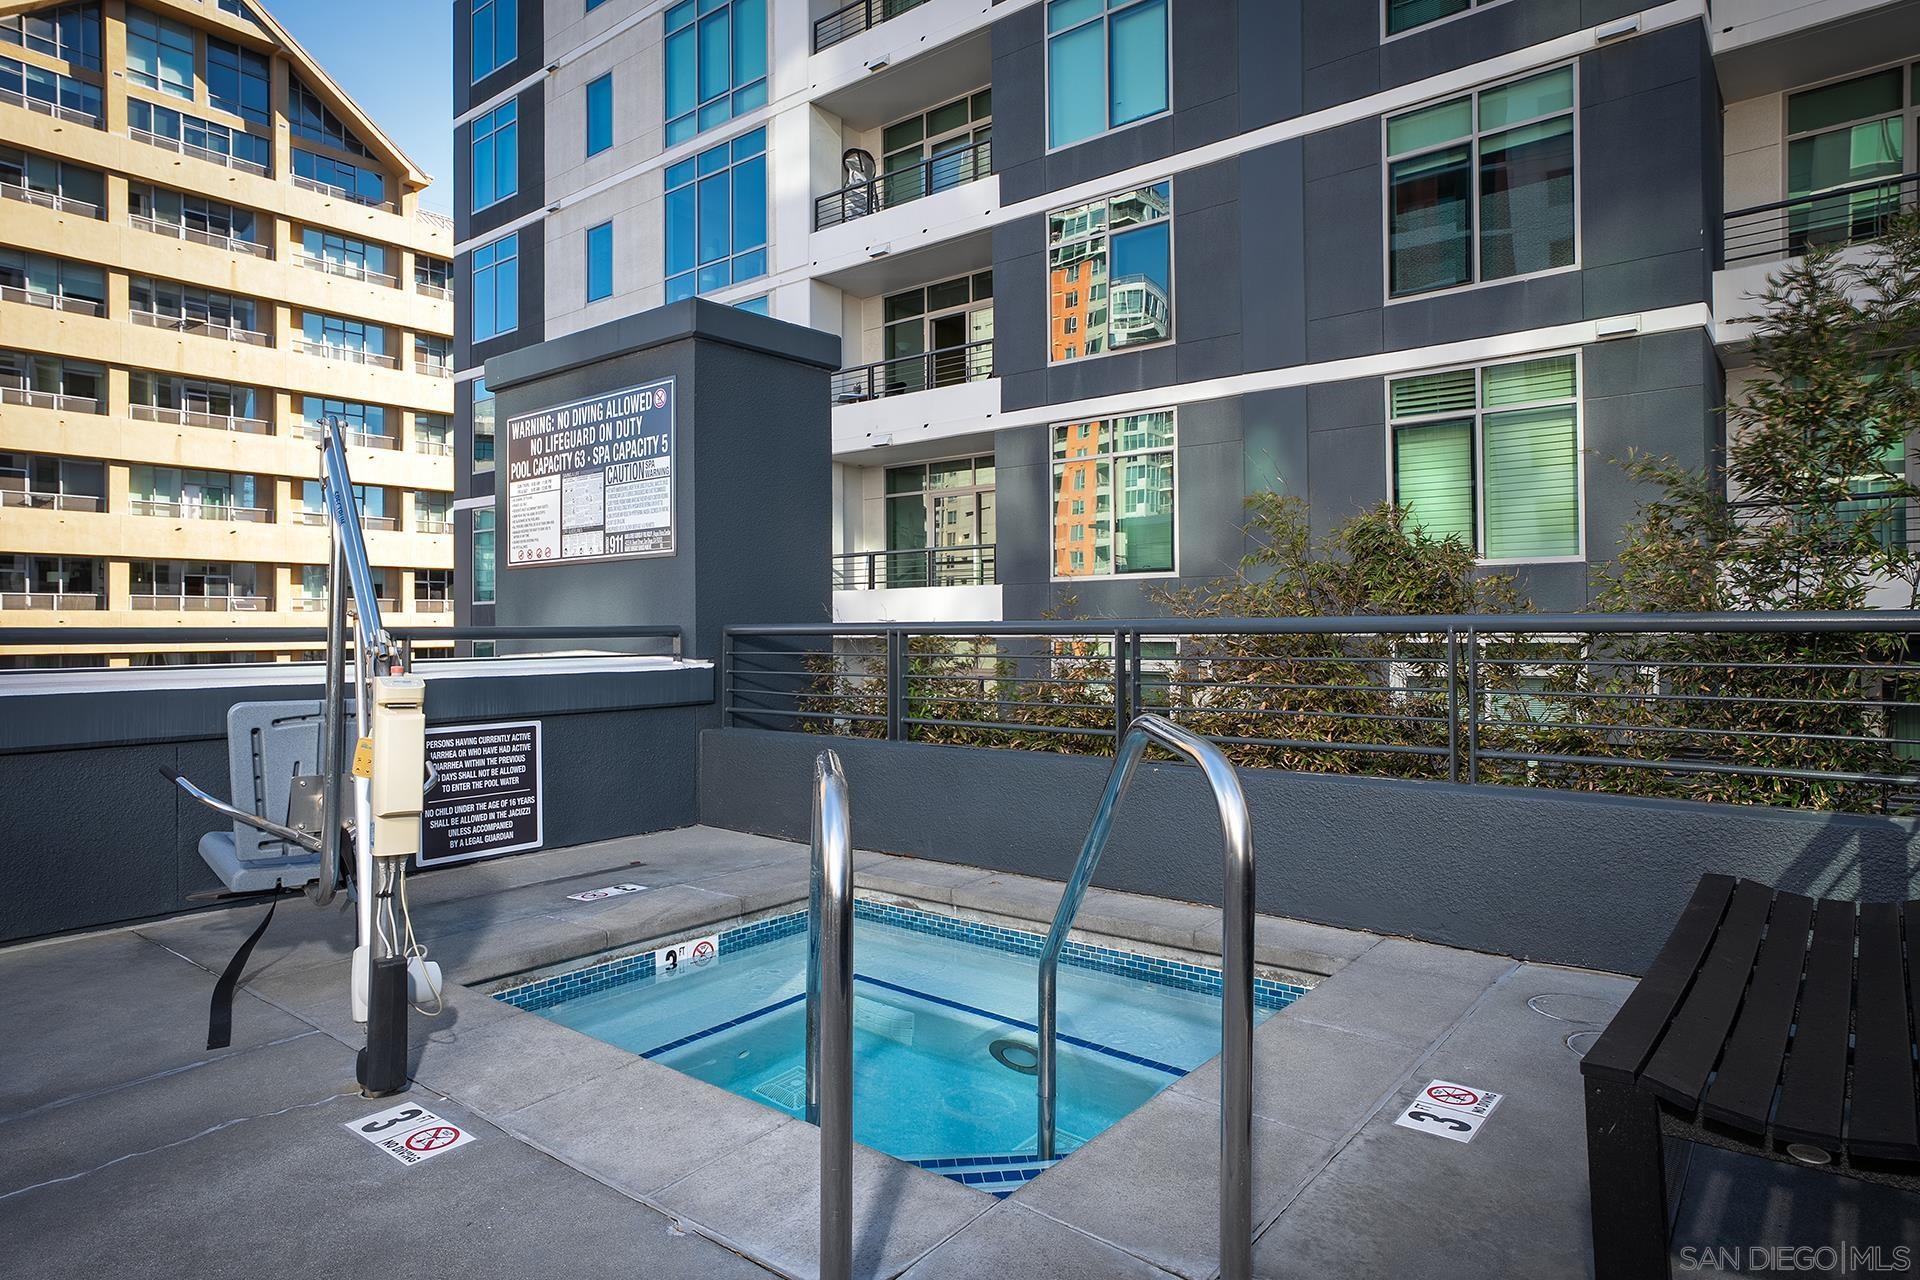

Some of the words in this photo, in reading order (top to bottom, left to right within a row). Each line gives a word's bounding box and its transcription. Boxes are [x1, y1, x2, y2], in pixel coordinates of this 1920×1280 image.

[512, 419, 554, 440] WARNING:
[558, 411, 569, 430] NO
[573, 406, 603, 427] DIVING
[606, 391, 652, 419] ALLOWED
[531, 438, 542, 456] NO
[546, 427, 595, 453] LIFEGUARD
[599, 423, 612, 442] ON
[617, 416, 643, 439] DUTY
[511, 462, 531, 480] POOL
[533, 452, 572, 476] CAPACITY
[575, 450, 585, 468] 63
[593, 445, 609, 465] SPA
[613, 437, 659, 461] CAPACITY
[662, 434, 668, 453] 5
[645, 460, 655, 469] SPA
[607, 462, 644, 484] CAUTION
[645, 467, 669, 478] WARNING
[610, 535, 623, 554] 911
[426, 739, 454, 749] PERSONS
[455, 737, 477, 746] HAVING
[478, 735, 510, 744] CURRENTLY
[512, 733, 531, 741] ACTIVE
[468, 748, 481, 756] WHO
[483, 746, 497, 754] HAVE
[499, 745, 510, 753] HAD
[512, 743, 531, 751] ACTIVE
[465, 758, 485, 768] WITHIN
[487, 757, 498, 765] THE
[499, 755, 525, 764] PREVIOUS
[442, 772, 457, 781] DAYS
[458, 769, 477, 779] SHALL
[478, 768, 490, 777] NOT
[500, 765, 526, 774] ALLOWED
[442, 784, 450, 792] TO
[452, 782, 471, 791] ENTER
[472, 781, 483, 789] THE
[484, 780, 499, 788] POOL
[500, 777, 519, 785] WATER
[425, 810, 434, 818] NO
[435, 807, 453, 816] CHILD
[455, 804, 475, 813] UNDER
[488, 801, 499, 809] AGE
[501, 799, 508, 807] OF
[517, 796, 535, 805] YEARS
[430, 819, 450, 828] SHALL
[460, 814, 487, 823] ALLOWED
[508, 807, 530, 817] JACUZZI
[448, 827, 471, 837] UNLESS
[472, 821, 513, 833] ACCOMPANIED
[450, 840, 458, 848] BY
[460, 839, 464, 847] A
[465, 836, 483, 845] LEGAL
[485, 831, 514, 842] GUARDIAN
[666, 950, 677, 970] 3
[679, 946, 685, 956] FT
[361, 1109, 423, 1132] 3
[1408, 1111, 1472, 1132] 3
[382, 1139, 399, 1148] NO
